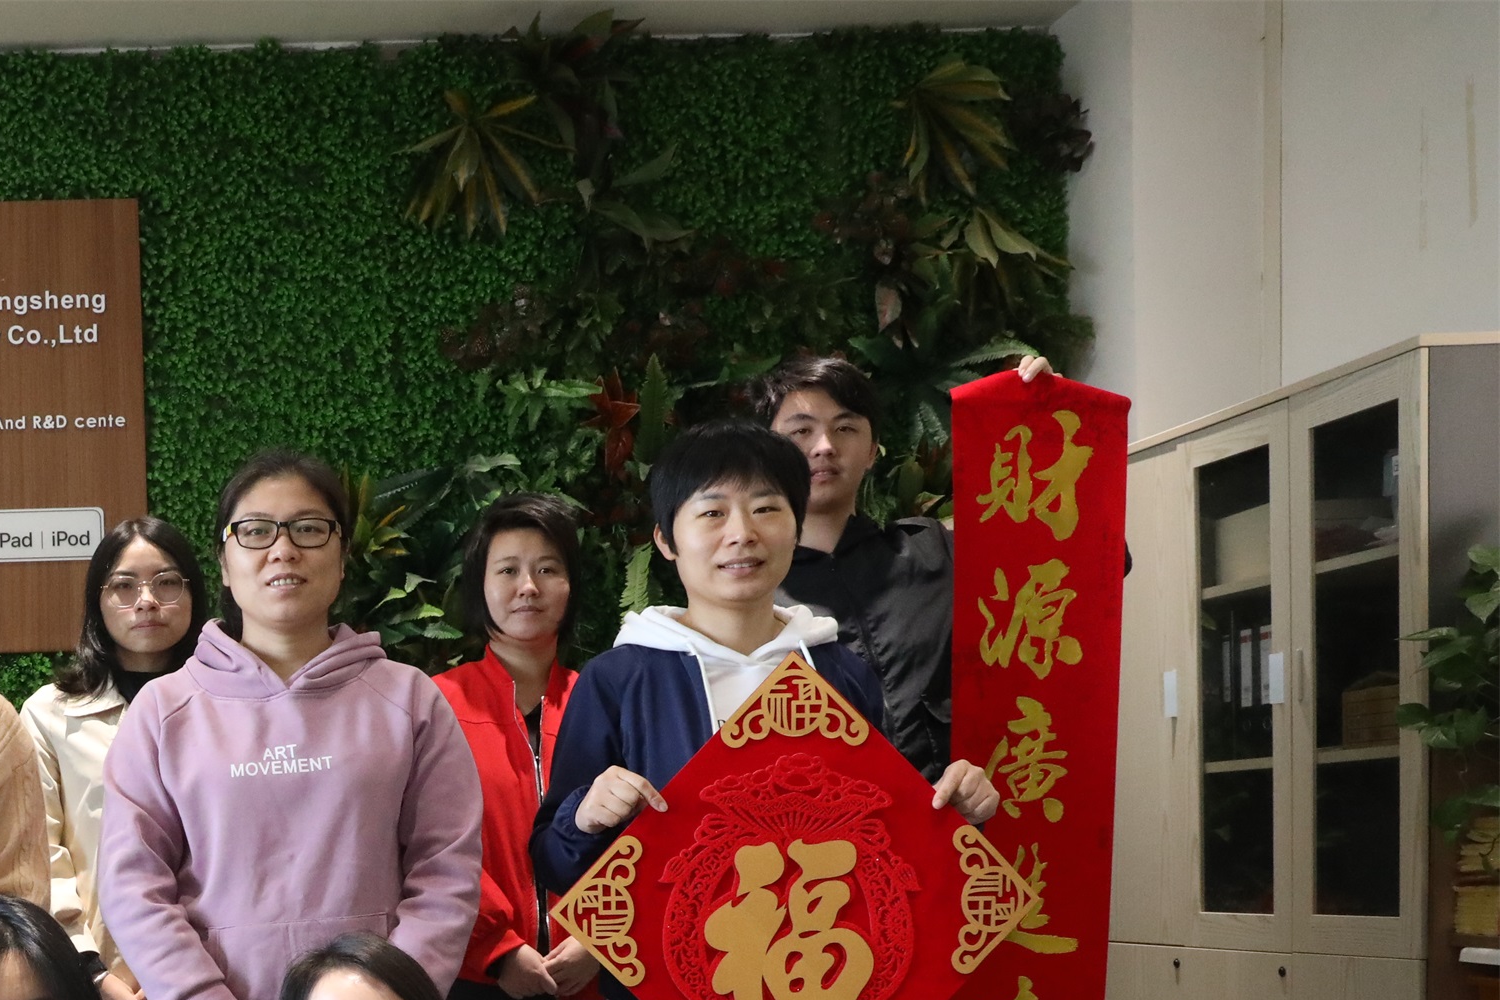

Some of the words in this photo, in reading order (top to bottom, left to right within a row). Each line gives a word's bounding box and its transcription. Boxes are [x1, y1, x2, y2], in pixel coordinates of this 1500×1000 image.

[7, 323, 99, 348] Co.,Ltd
[32, 414, 67, 429] R&D
[74, 413, 126, 428] cente
[51, 530, 91, 547] iPod
[263, 744, 297, 761] ART
[230, 756, 333, 778] MOVEMENT
